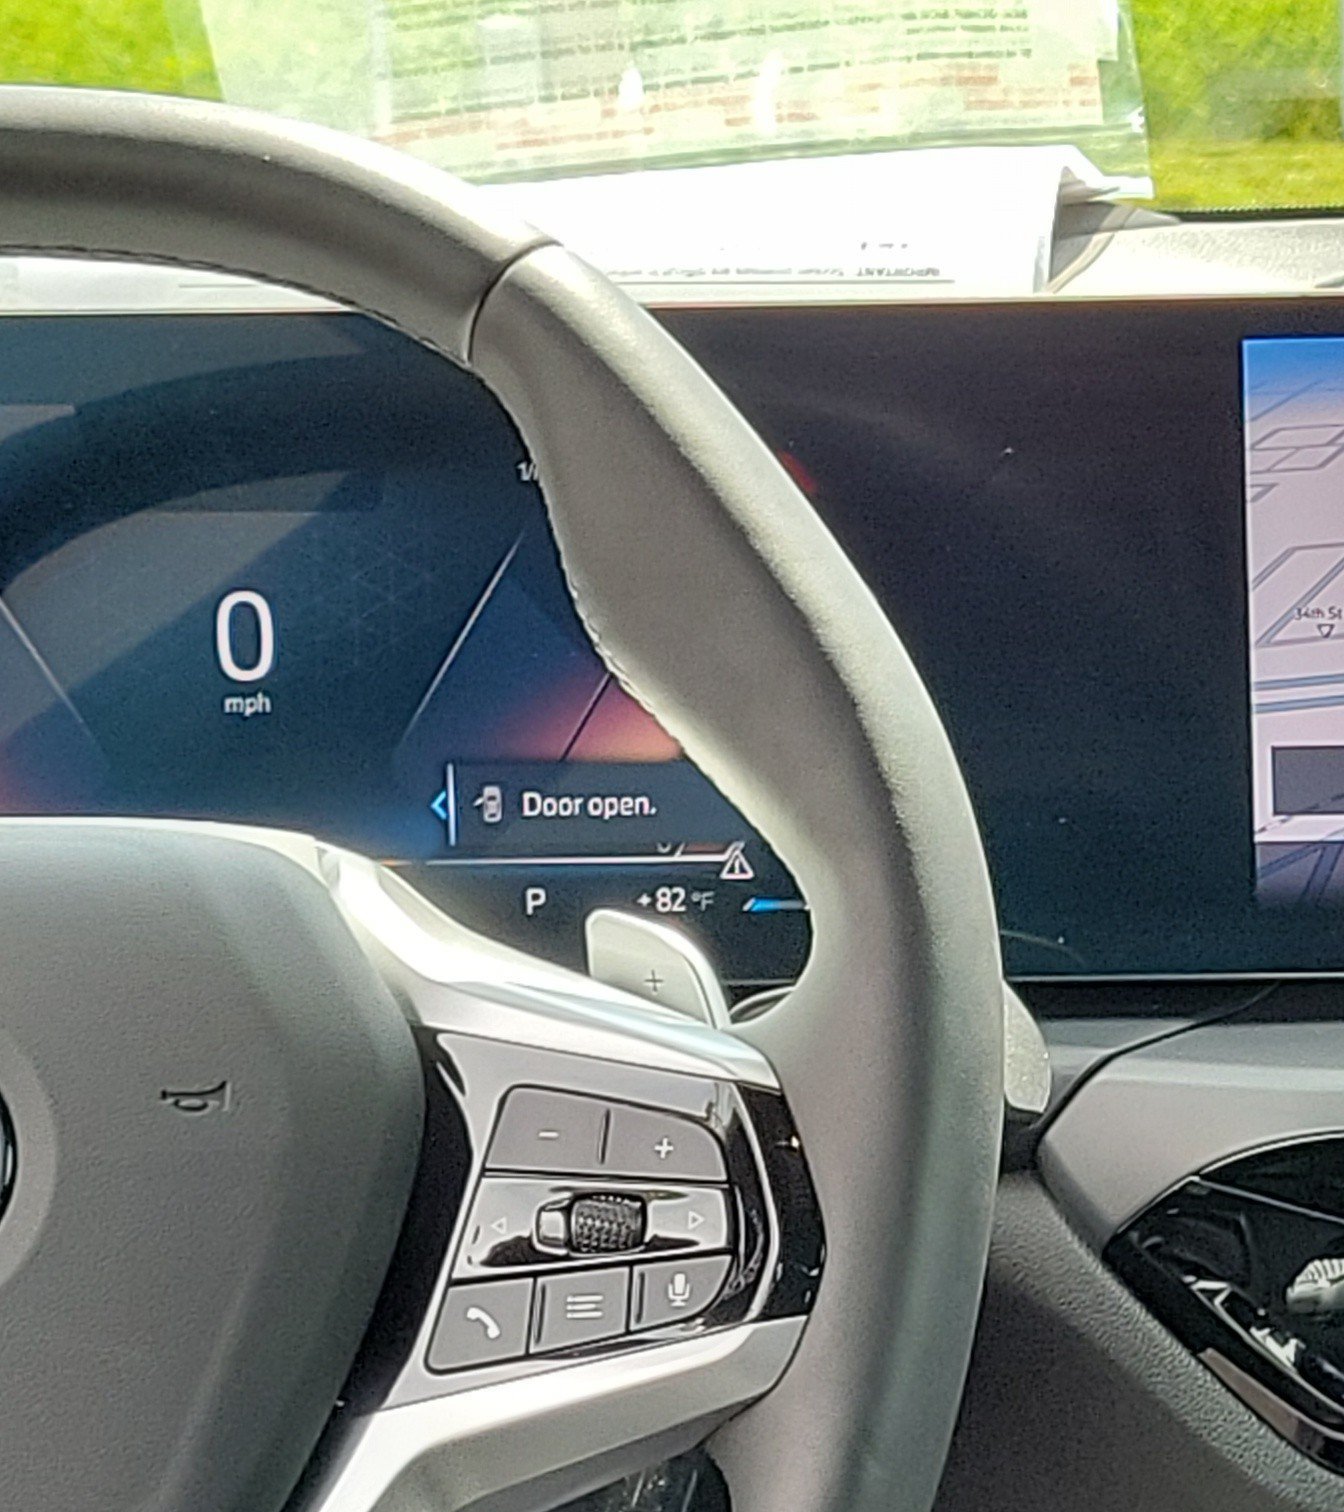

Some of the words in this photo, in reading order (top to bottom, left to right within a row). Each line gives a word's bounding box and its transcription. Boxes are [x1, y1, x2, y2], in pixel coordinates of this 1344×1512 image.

[1328, 607, 1342, 619] St
[216, 588, 274, 682] 0
[224, 691, 271, 717] mph
[522, 791, 583, 817] Door
[587, 795, 658, 820] open.
[525, 887, 546, 916] P
